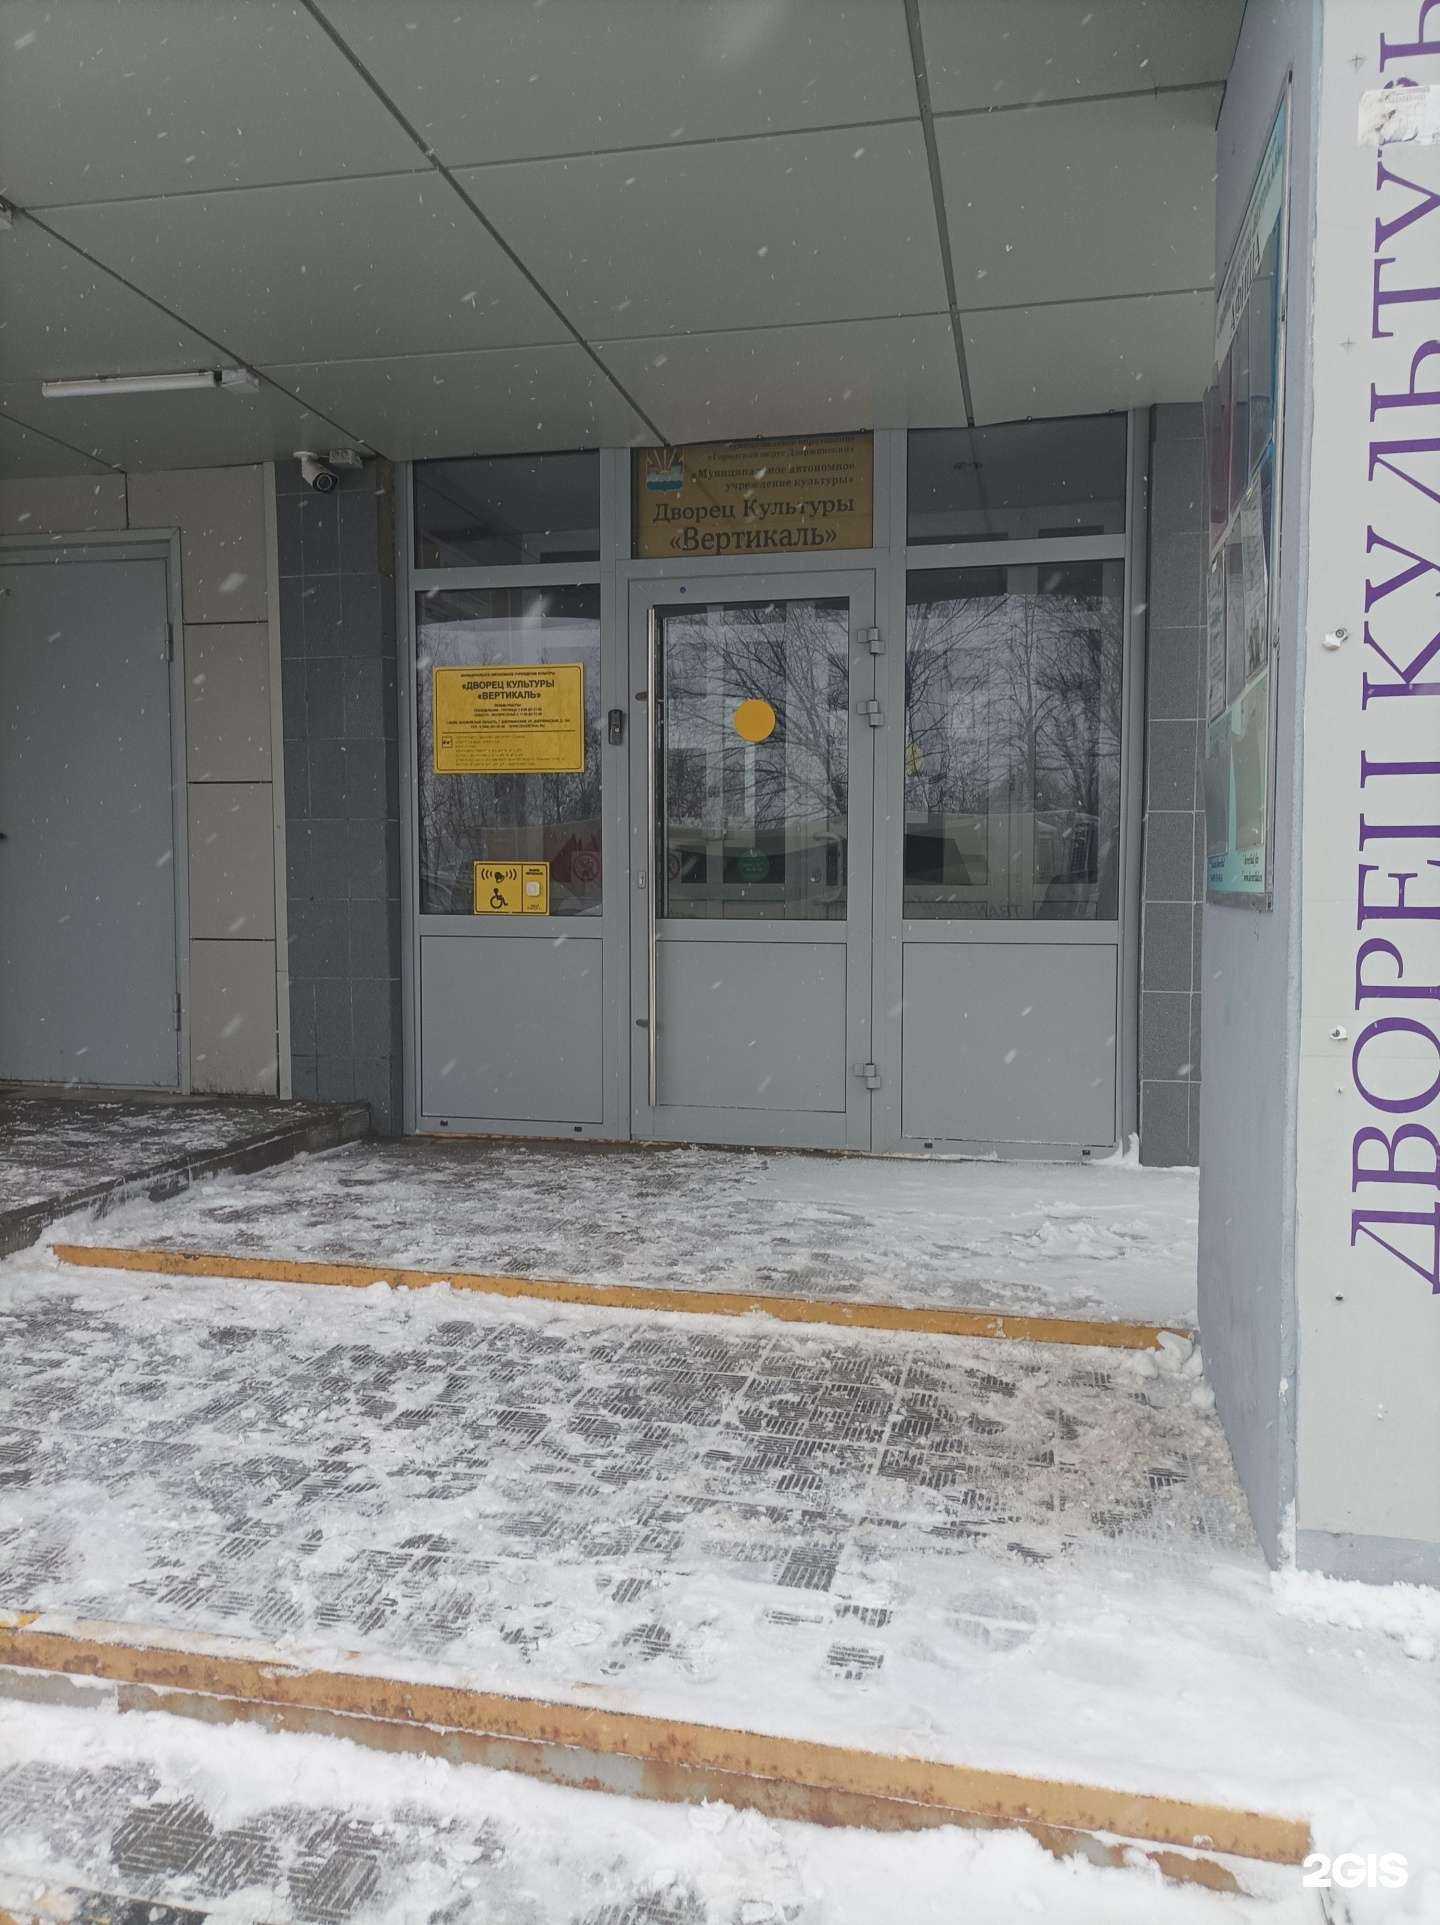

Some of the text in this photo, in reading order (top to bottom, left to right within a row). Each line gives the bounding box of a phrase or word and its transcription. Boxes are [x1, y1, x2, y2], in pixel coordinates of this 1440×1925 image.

[1362, 0, 1440, 710] КУЛЬТУ
[653, 497, 855, 523] Дворец Культуры
[669, 526, 838, 555] «Вертикаль»
[477, 690, 541, 700] «ВЕРТИКАЛЬ»
[506, 679, 555, 689] КУЛЬТУРЫ
